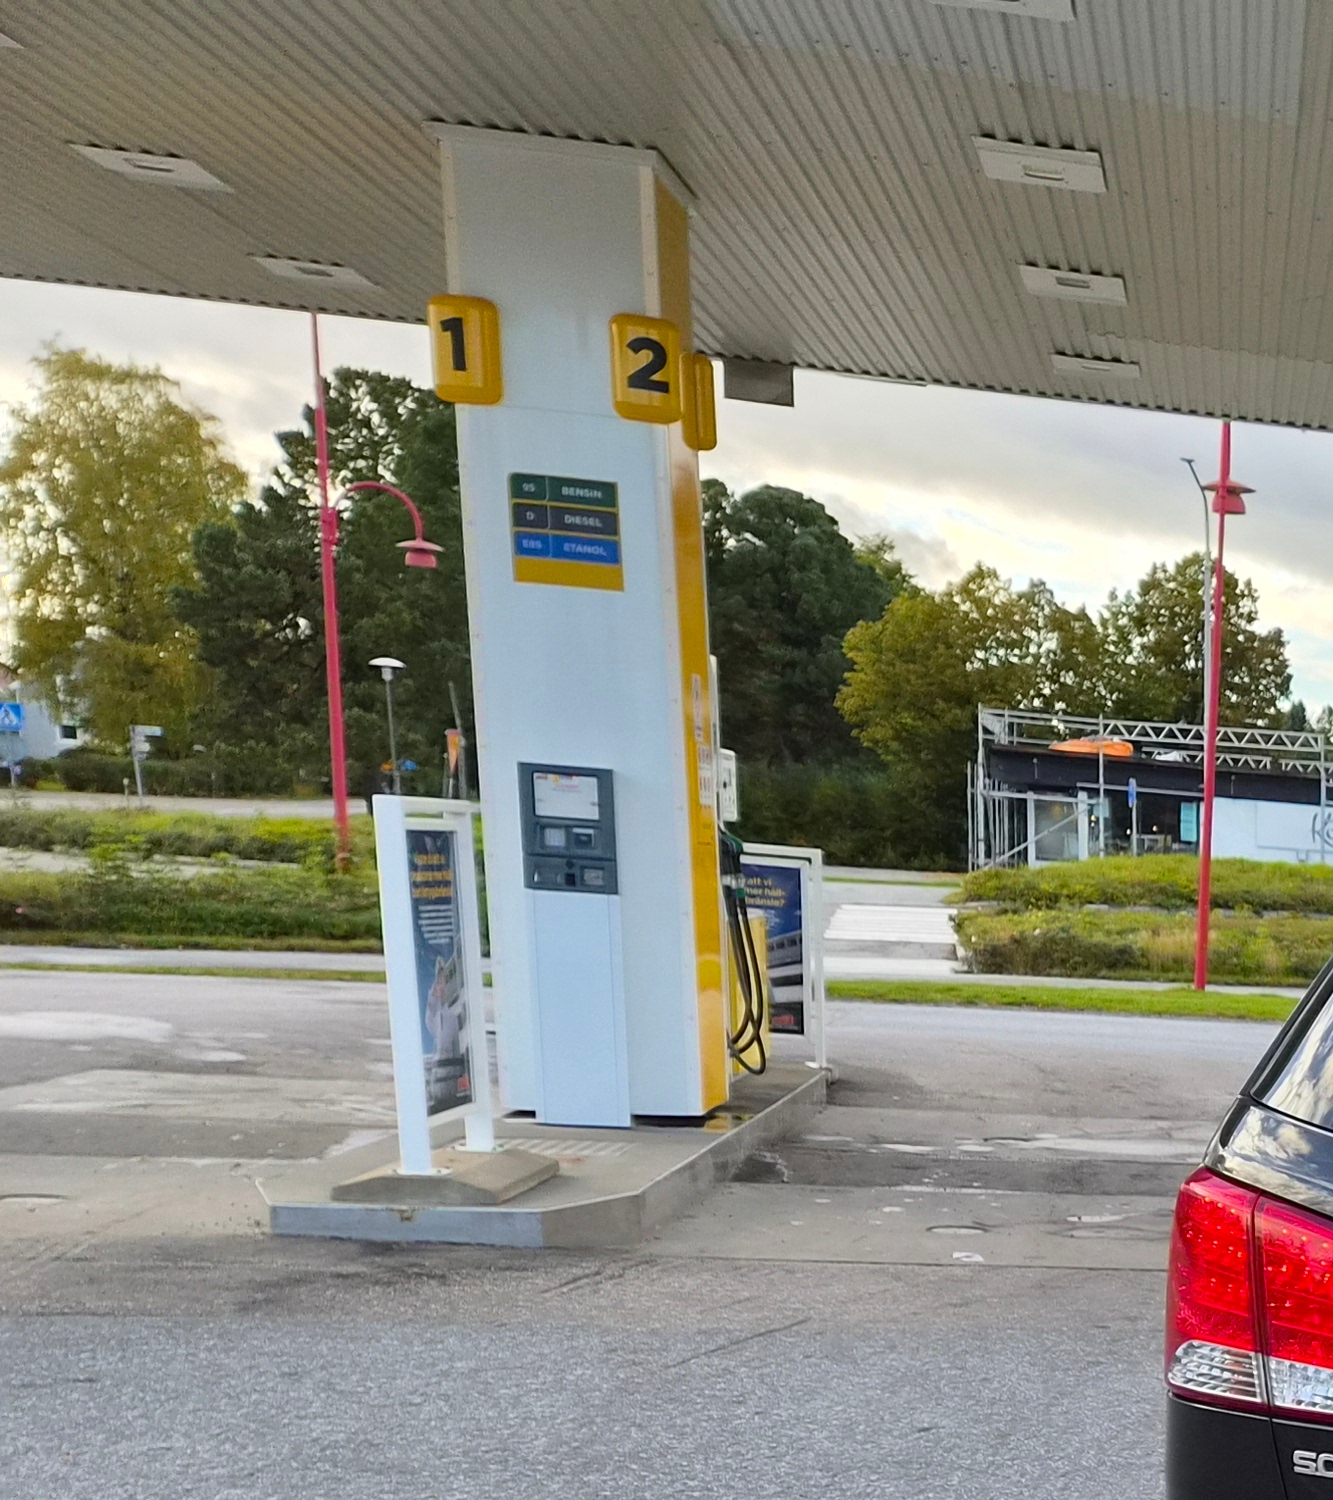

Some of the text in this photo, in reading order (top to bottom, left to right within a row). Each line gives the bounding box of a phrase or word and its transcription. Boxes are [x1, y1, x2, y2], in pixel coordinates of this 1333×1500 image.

[440, 316, 467, 372] 1
[626, 337, 669, 394] 2
[522, 482, 602, 499] 95 BENSIN
[525, 511, 603, 527] D DIESEL
[562, 542, 607, 556] ETANOL
